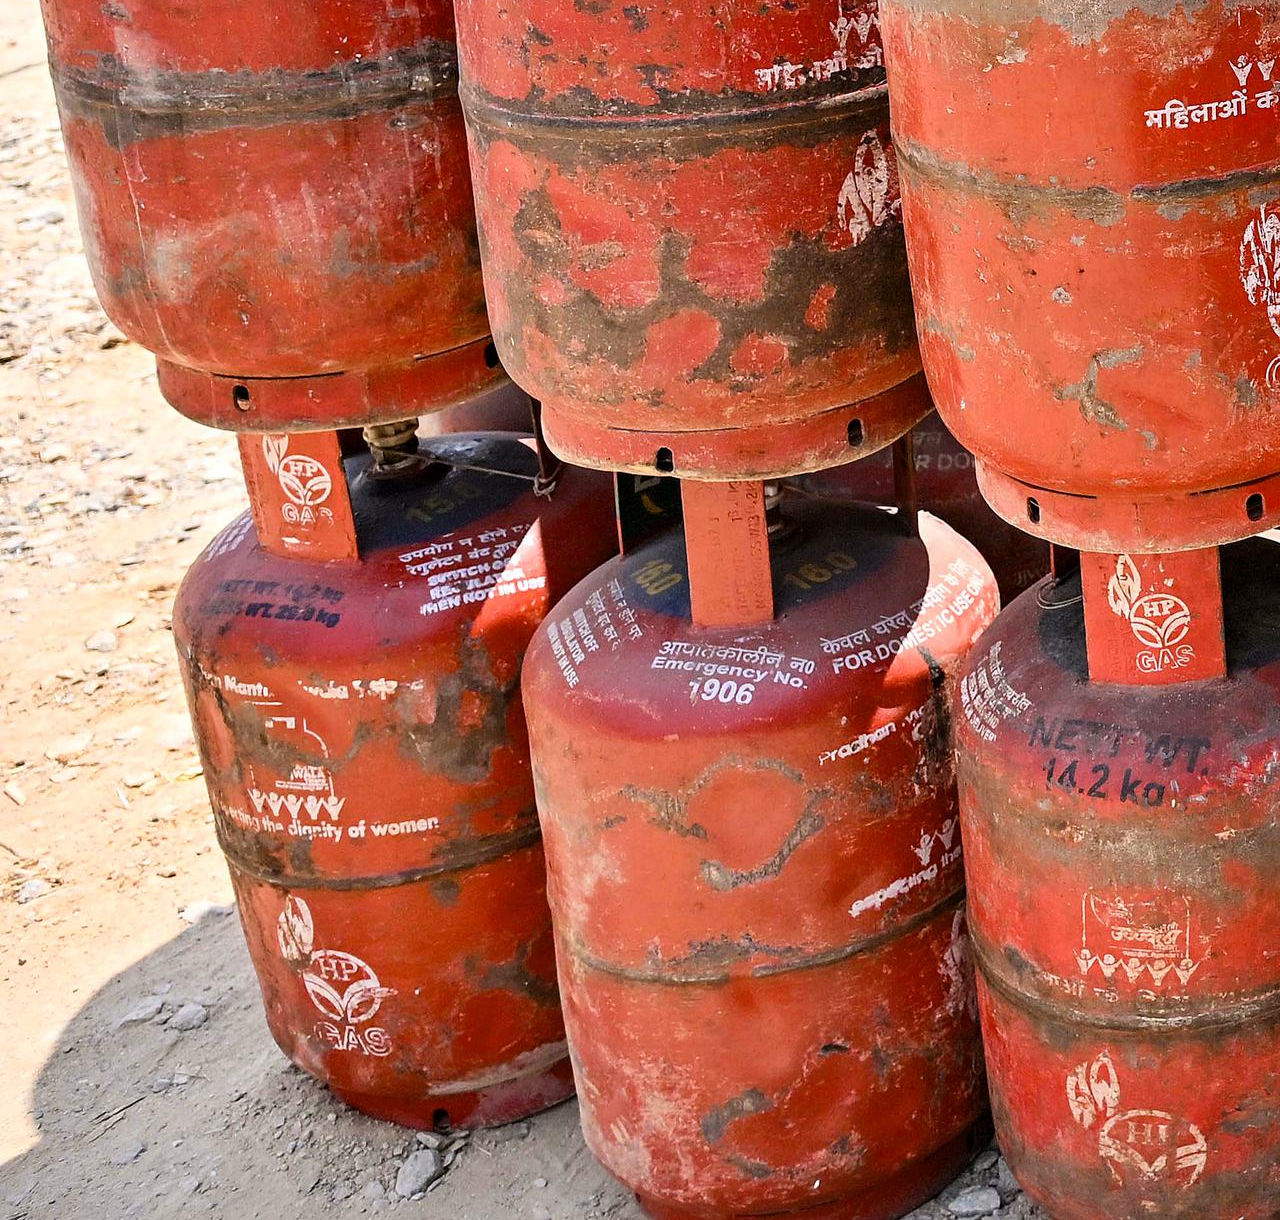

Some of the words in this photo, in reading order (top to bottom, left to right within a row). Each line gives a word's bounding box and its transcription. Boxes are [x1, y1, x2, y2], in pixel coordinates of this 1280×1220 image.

[1144, 90, 1248, 130] महिलाओं
[288, 461, 320, 477] HP
[463, 587, 496, 604] NOT
[498, 581, 518, 597] IN
[1143, 598, 1176, 618] HP
[584, 634, 600, 653] OFF
[820, 629, 868, 657] केवल
[832, 650, 874, 675] FOR
[875, 611, 954, 662] DOMESTIC
[949, 591, 976, 621] USE
[553, 641, 566, 661] NOT
[563, 665, 580, 689] USE
[651, 656, 769, 682] Emergency
[772, 670, 809, 689] No.
[1136, 645, 1197, 673] GAS
[688, 678, 755, 707] 1906
[1042, 758, 1109, 799] 14.2
[288, 818, 342, 843] dignity
[348, 818, 366, 838] of
[370, 815, 440, 838] women
[318, 958, 359, 981] HP
[314, 1020, 393, 1057] GAS
